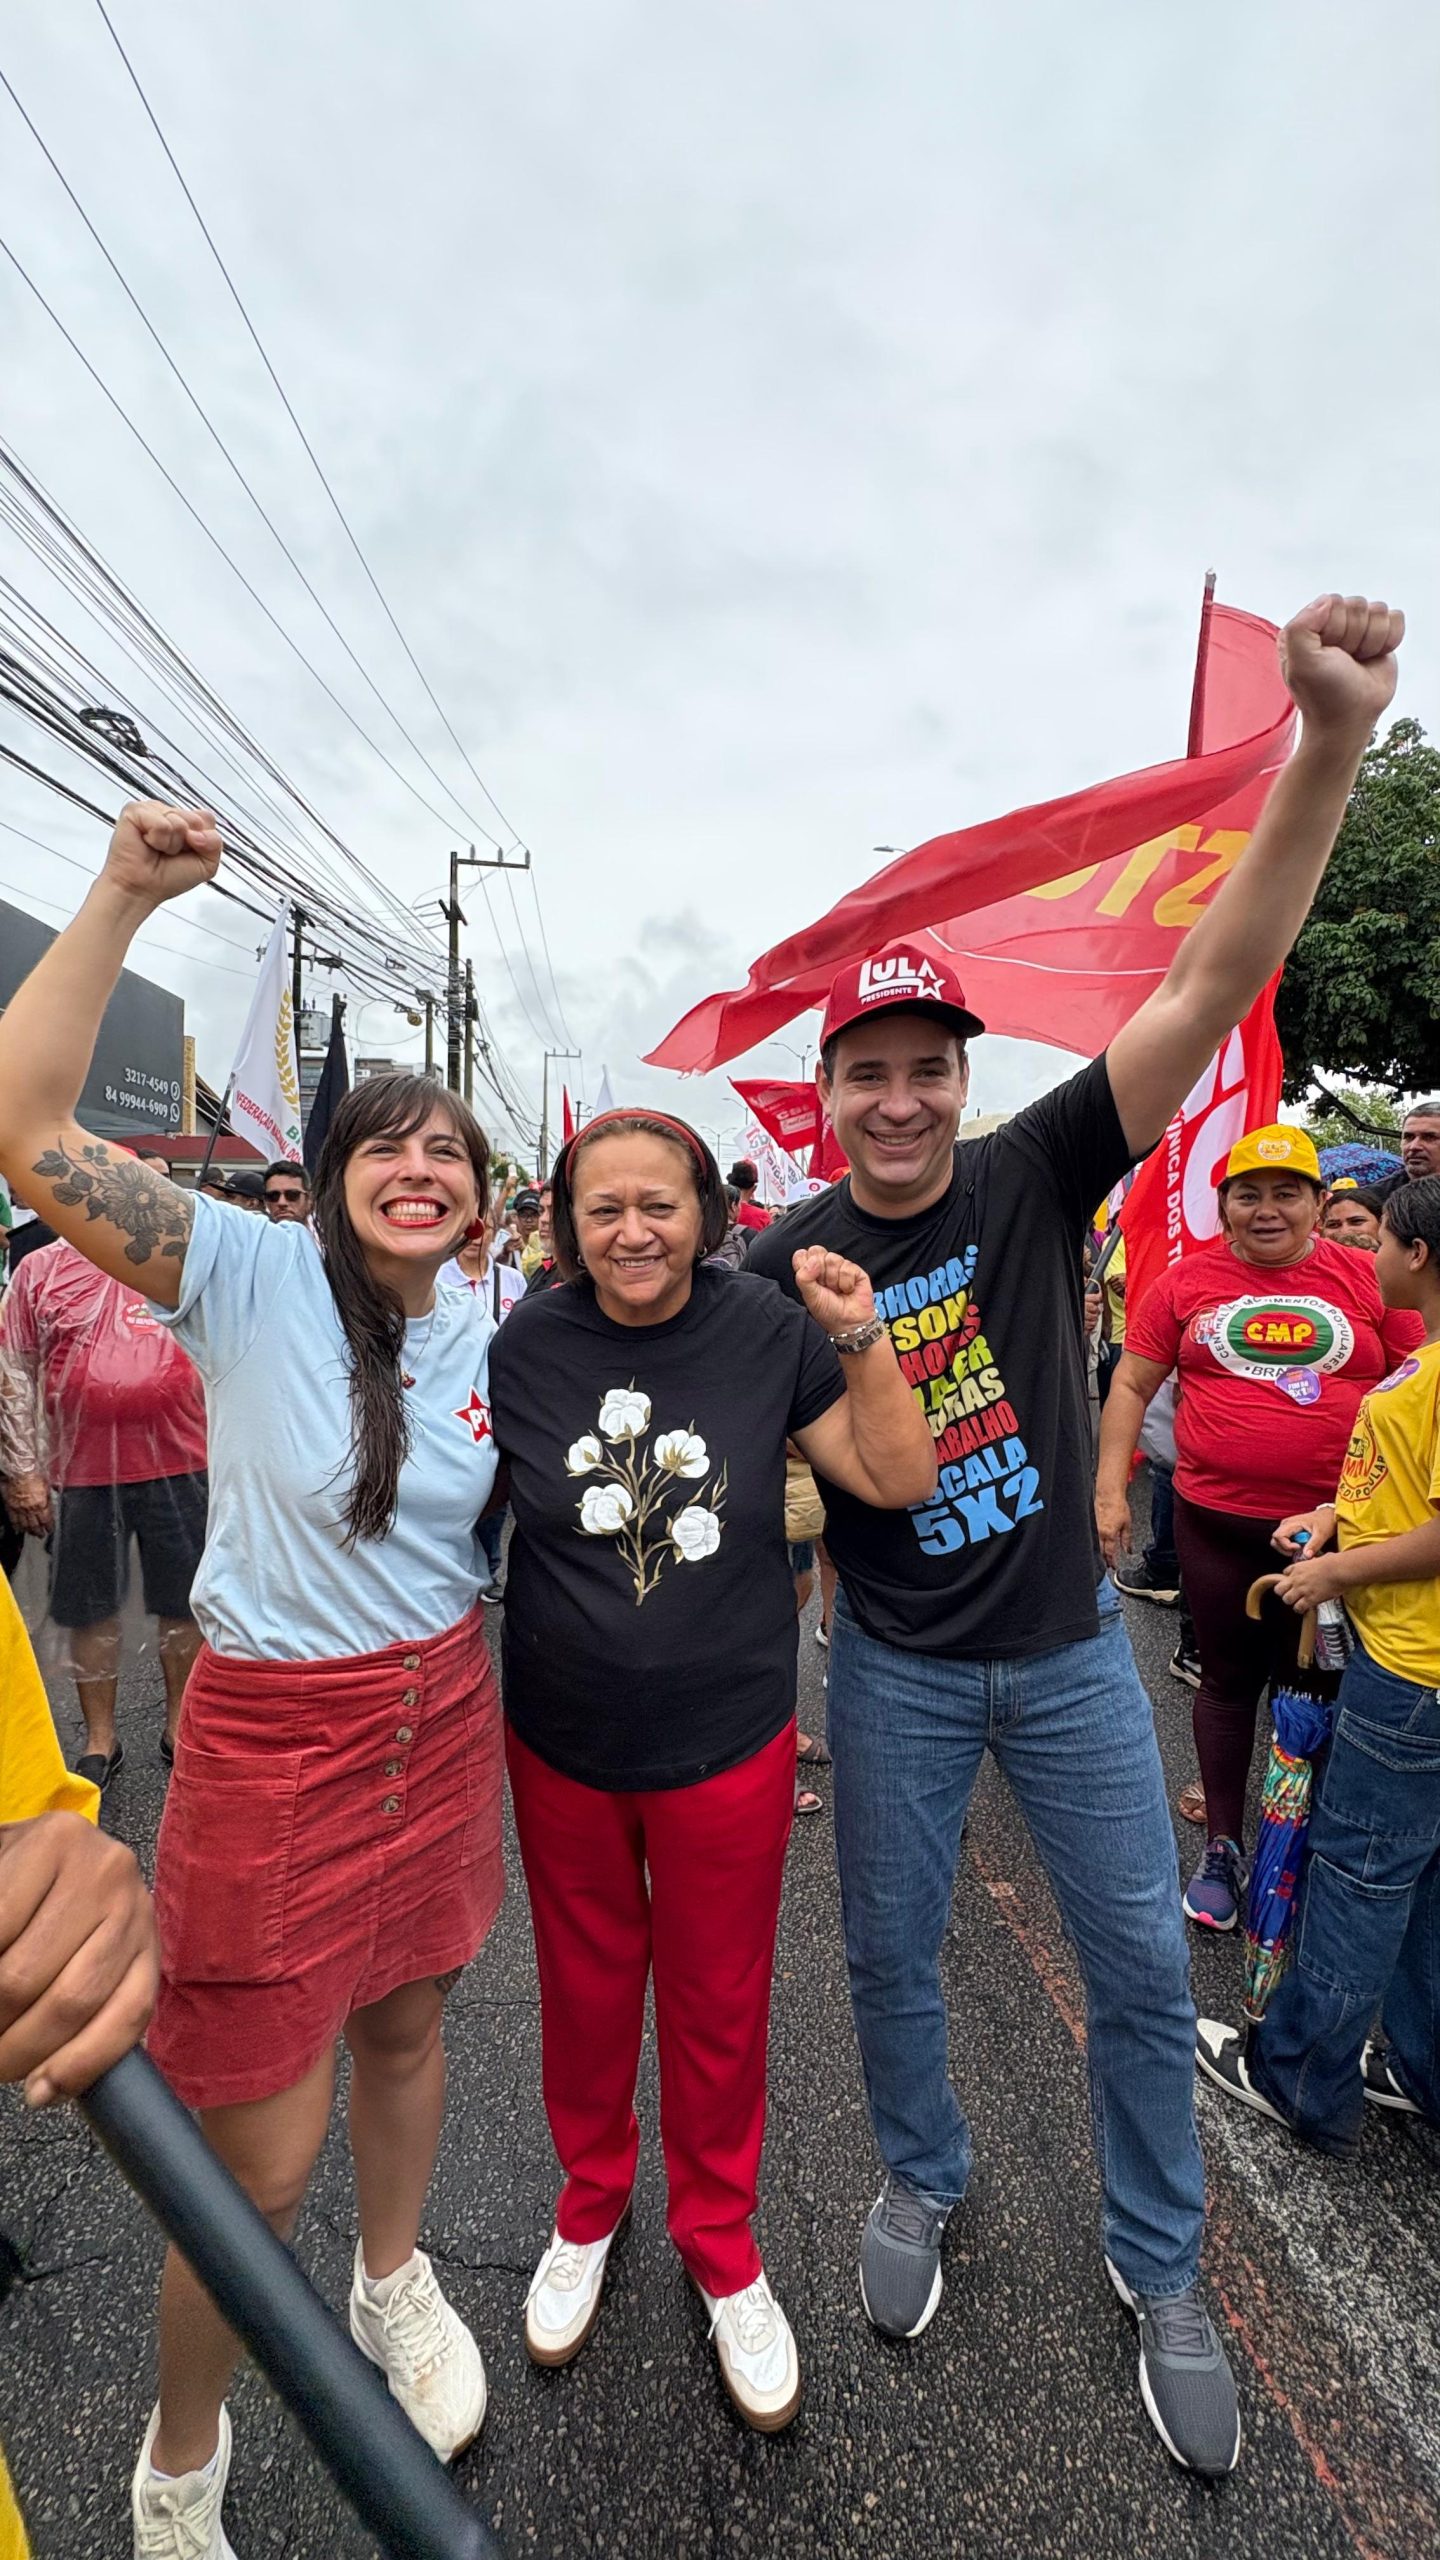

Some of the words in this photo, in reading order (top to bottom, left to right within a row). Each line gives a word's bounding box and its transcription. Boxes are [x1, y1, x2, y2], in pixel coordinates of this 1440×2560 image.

[858, 957, 942, 999] LULA
[861, 987, 912, 1005] PRESIDENTE
[105, 1085, 118, 1103] 84
[119, 1091, 168, 1118] 99944-6909
[124, 1067, 169, 1095] 3217-4549
[1167, 1189, 1183, 1240] DOS
[891, 1284, 974, 1352] SON
[1247, 1322, 1312, 1343] CMP
[1322, 1308, 1350, 1372] POPULARES
[1251, 1366, 1286, 1378] BRA
[467, 1407, 491, 1432] PT
[936, 1400, 1019, 1465] ABALHO
[906, 1436, 1028, 1512] CALA
[911, 1466, 1045, 1556] 5X2
